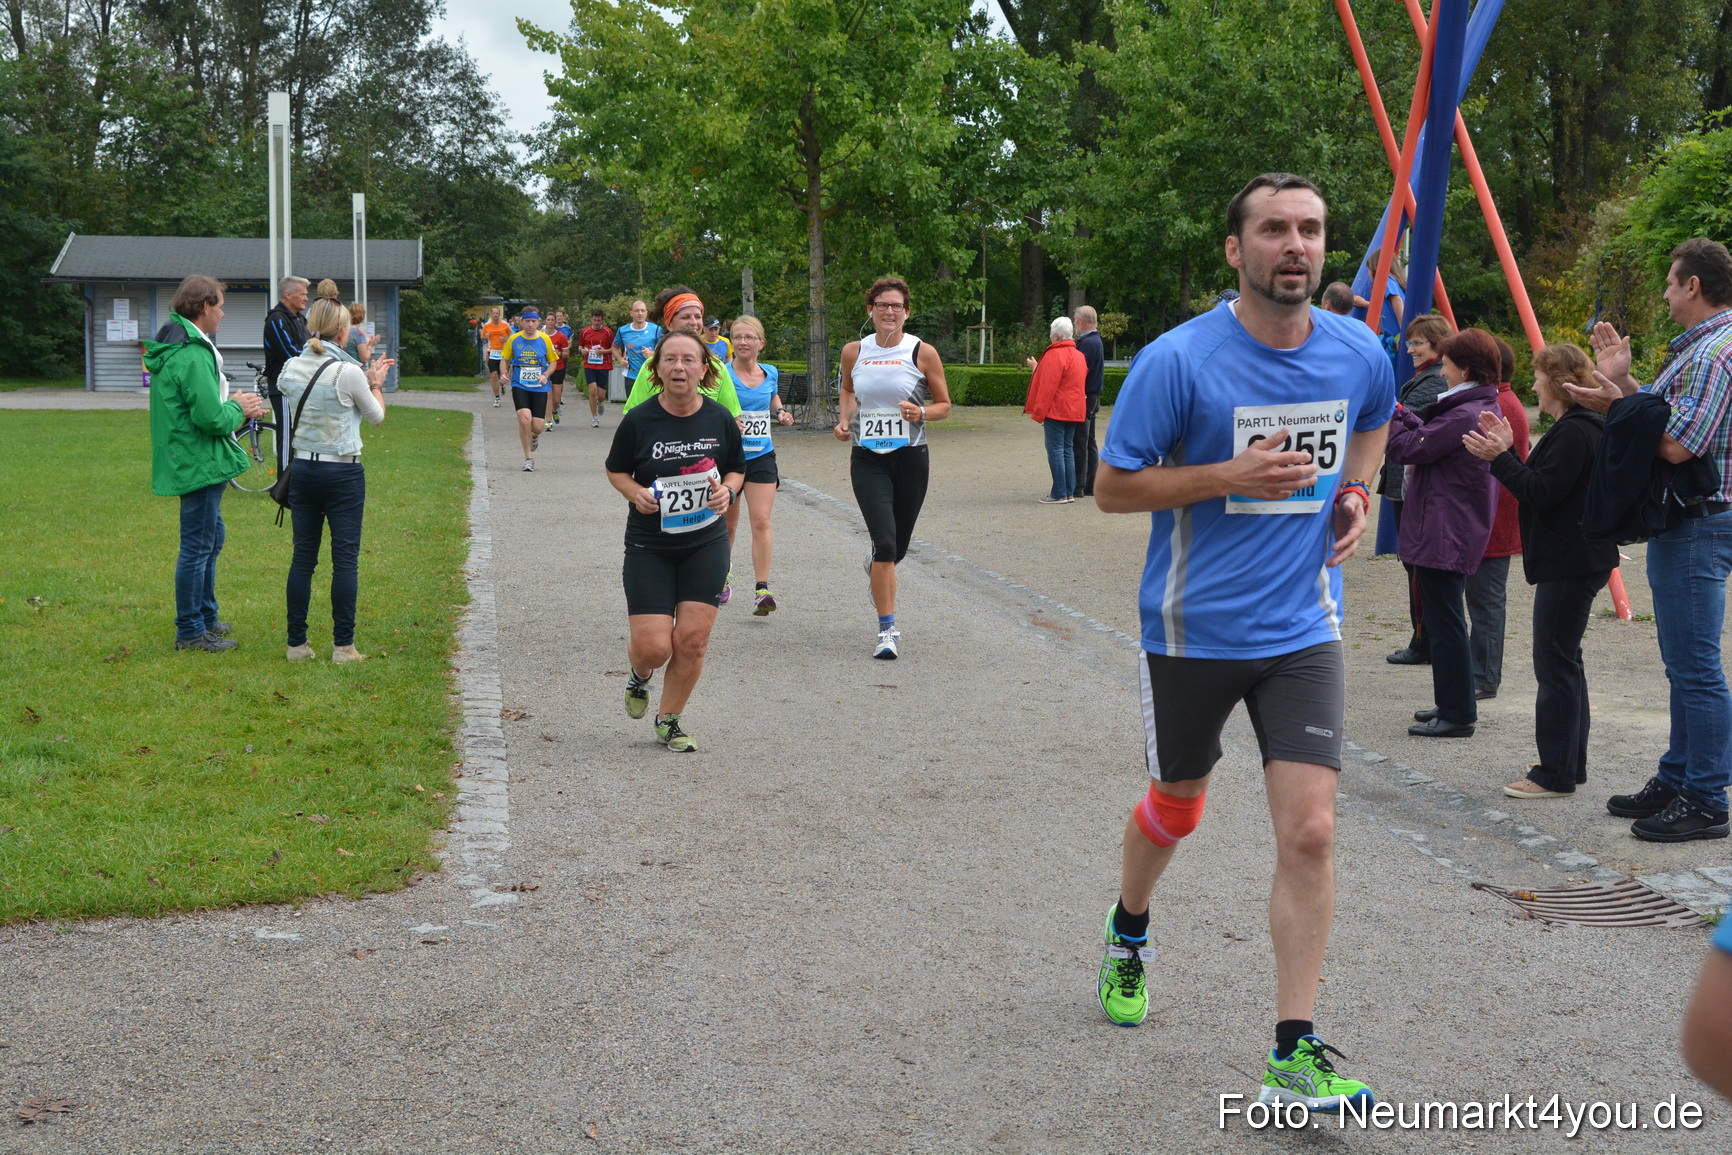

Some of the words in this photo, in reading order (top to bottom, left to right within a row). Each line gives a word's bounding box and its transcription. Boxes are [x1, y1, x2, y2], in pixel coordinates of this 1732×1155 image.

[740, 420, 767, 436] 262
[865, 419, 903, 437] 2411
[1237, 417, 1275, 429] PARTL
[1278, 413, 1330, 426] Neumarkt
[875, 440, 893, 448] Petra
[683, 513, 706, 525] Helga
